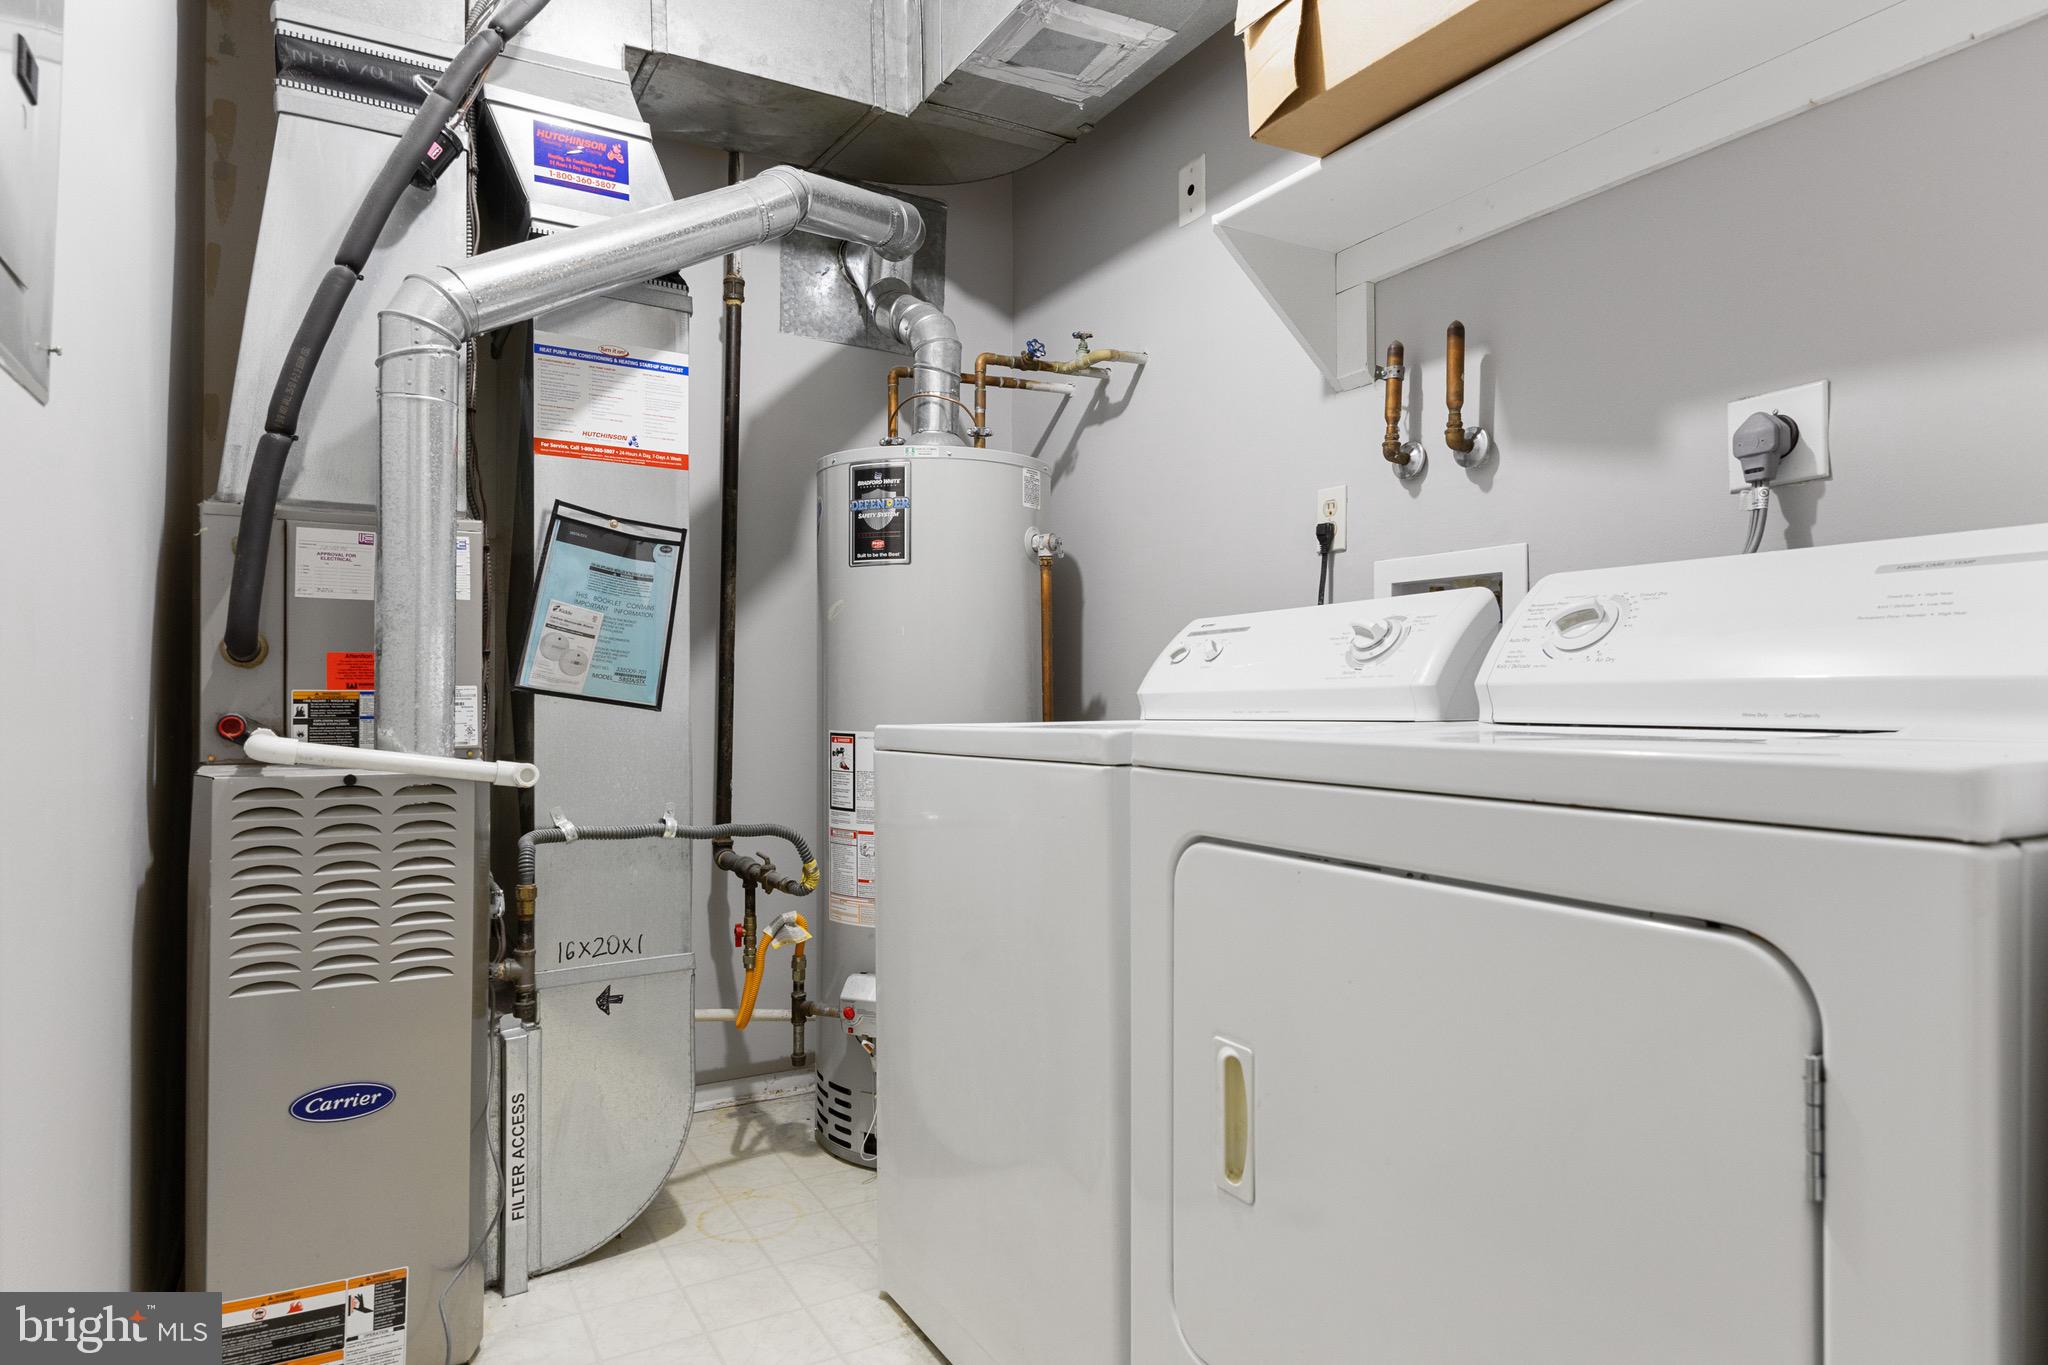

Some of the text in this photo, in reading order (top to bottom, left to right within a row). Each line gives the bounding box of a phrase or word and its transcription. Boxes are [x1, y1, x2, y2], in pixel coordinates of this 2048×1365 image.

[536, 128, 607, 152] HUTCHINSON
[548, 169, 617, 190] 1-800-360-5807
[539, 346, 552, 354] HEAT
[578, 352, 613, 363] CONDITIONING
[618, 358, 639, 366] HEATING
[581, 430, 628, 441] HUTCHINSON
[857, 479, 883, 487] BRADFORD
[850, 497, 911, 512] DEFENDER
[575, 591, 656, 611] THIS BOOKLET CONTAINS
[575, 599, 654, 618] IMPORTANT INFORMATION
[345, 652, 373, 660] Attention
[591, 671, 613, 681] MODEL
[305, 1093, 382, 1113] Carrier
[512, 1092, 525, 1221] FILTER ACCESS
